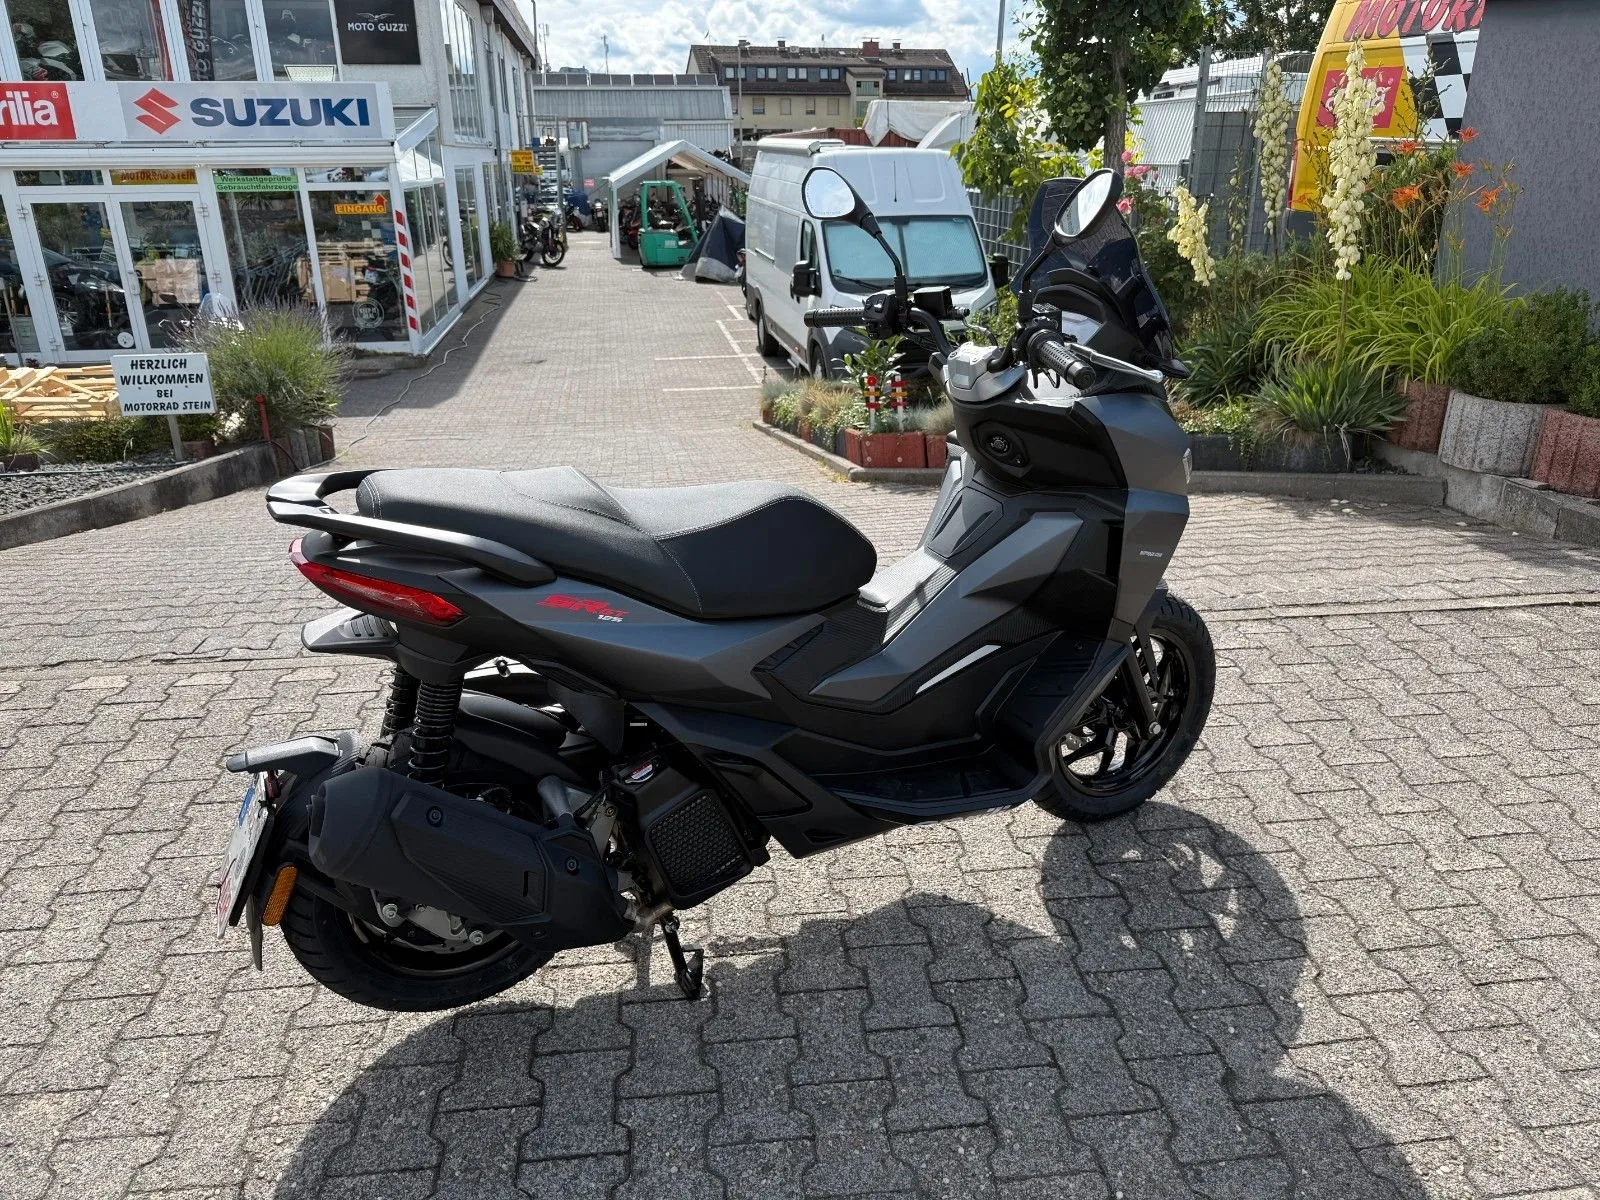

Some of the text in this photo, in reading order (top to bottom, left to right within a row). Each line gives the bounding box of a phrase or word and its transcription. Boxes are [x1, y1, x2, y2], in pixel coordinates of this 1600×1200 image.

[347, 22, 408, 32] MOTO GUZZI
[190, 97, 370, 127] SUZUKI
[120, 170, 167, 181] MOTORRAD
[216, 183, 298, 191] Gebrauchtfahrzeuge
[336, 204, 385, 214] EINGANG
[130, 358, 187, 370] HERZLICH
[120, 373, 204, 386] WILLKOMMEN
[156, 389, 173, 398] BEI
[123, 400, 211, 412] MOTORRAD STEIN
